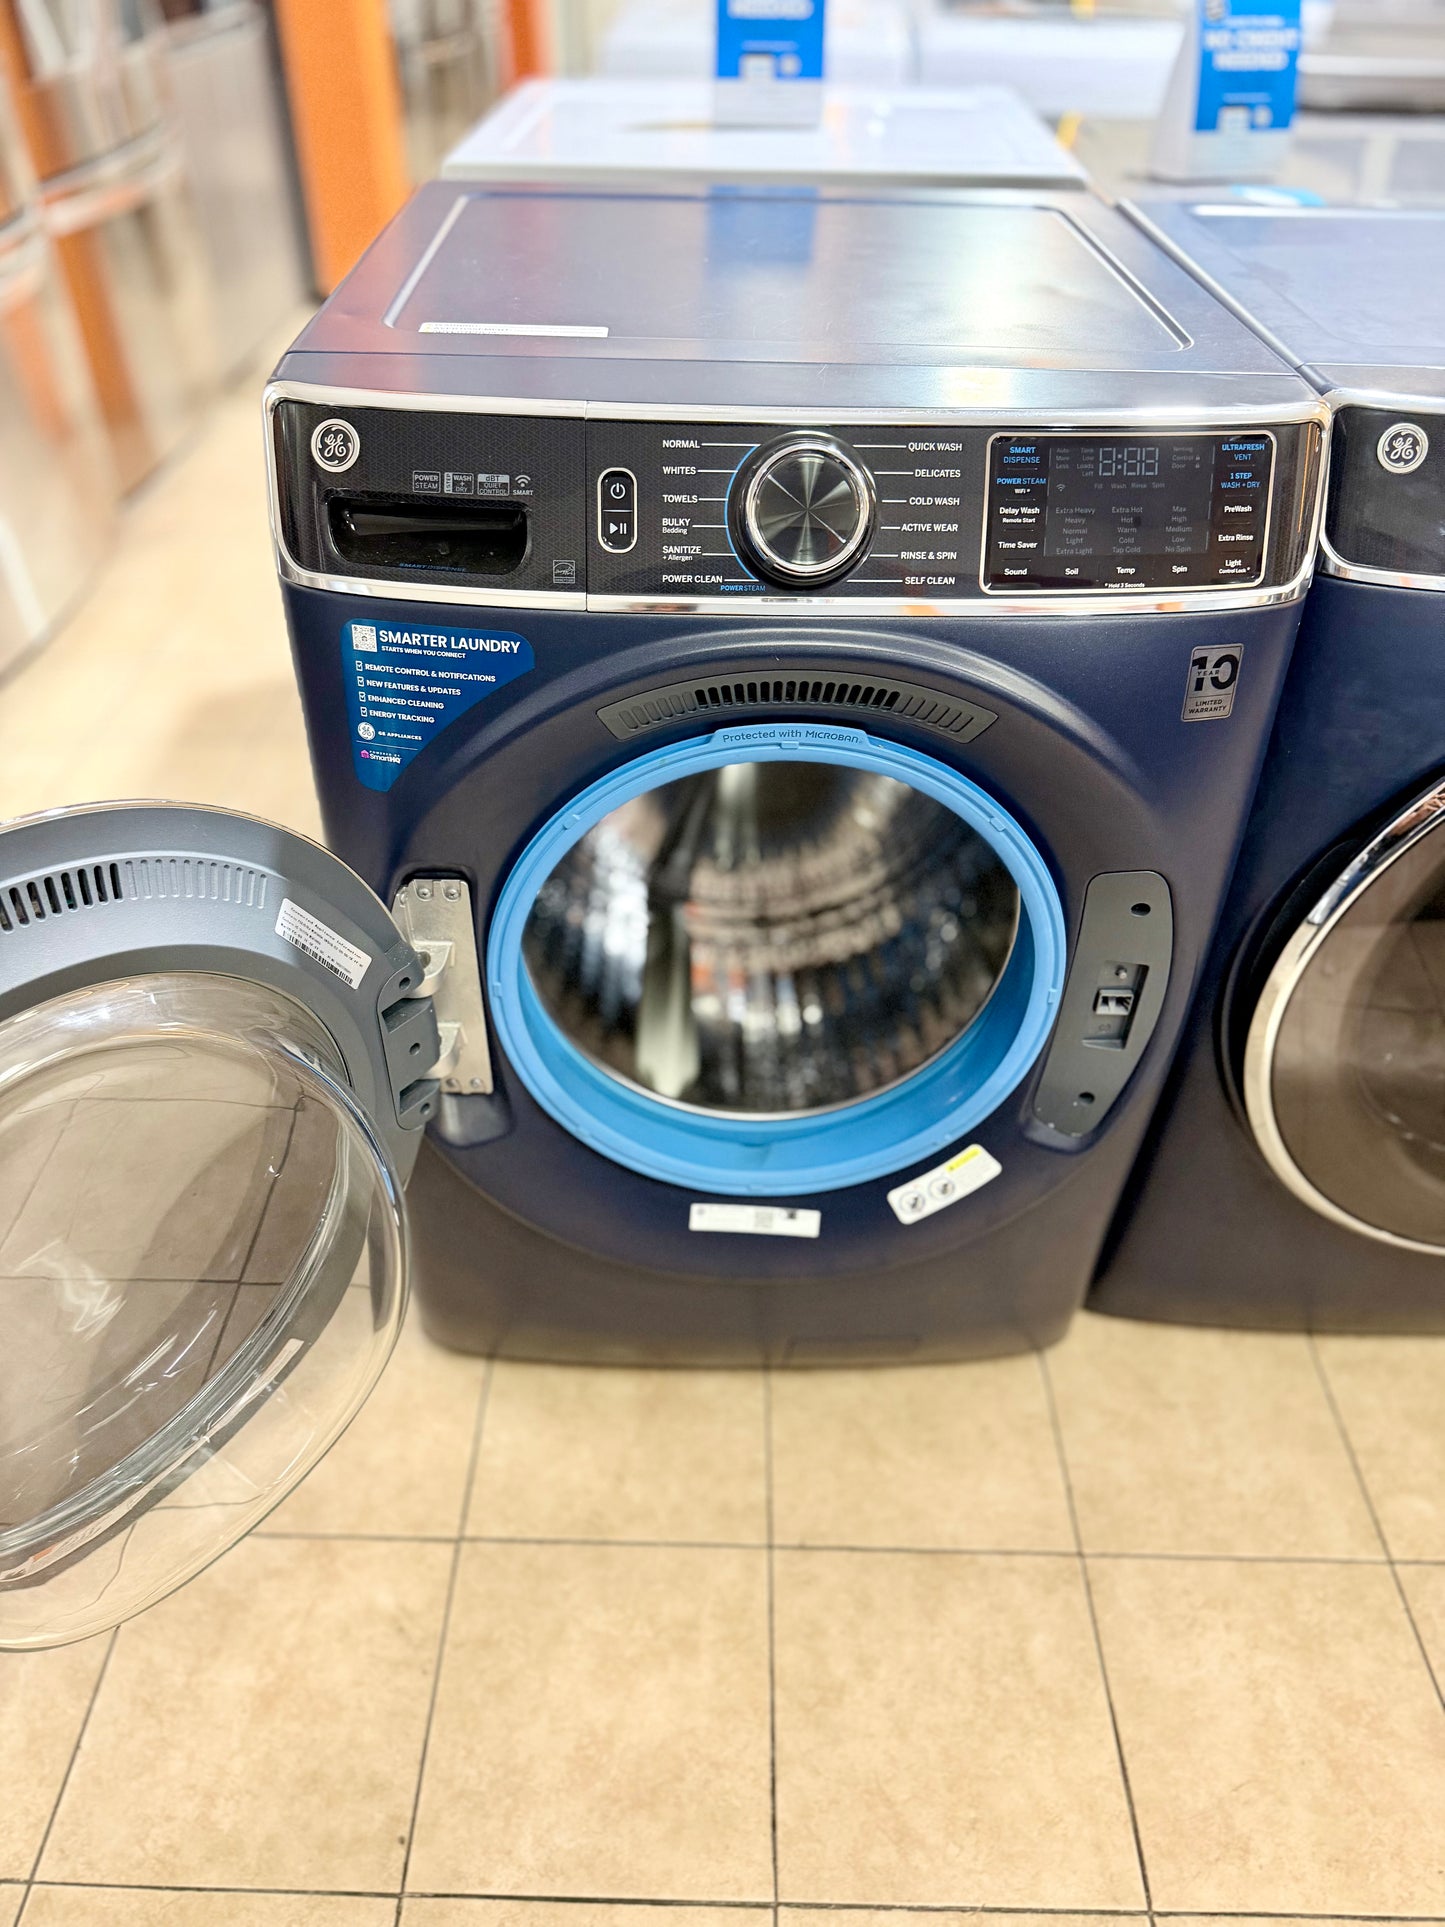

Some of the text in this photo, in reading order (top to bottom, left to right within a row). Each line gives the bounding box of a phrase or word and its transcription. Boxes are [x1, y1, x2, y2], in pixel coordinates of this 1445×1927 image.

[662, 440, 700, 448] NORMAL
[908, 442, 963, 452] QUICK WASH
[1004, 456, 1040, 464] DISPENSE
[662, 466, 697, 475] WHITES
[914, 469, 961, 478] DELICATES
[662, 495, 698, 503] TOWELS
[909, 497, 960, 506] COLD WASH
[999, 507, 1019, 516] Delay
[1075, 507, 1095, 515] Heavy
[1224, 505, 1252, 513] PreWash
[662, 518, 690, 526] BULKY
[662, 527, 688, 535] Bedding
[901, 523, 958, 532] ACTIVE WEAR
[662, 546, 702, 554] SANITIZE
[1075, 547, 1092, 555] Light
[901, 552, 957, 560] RINSE & SPIN
[1225, 560, 1242, 568] Light
[1004, 568, 1028, 576] Sound
[1116, 567, 1136, 575] Temp
[1172, 565, 1188, 574] Spin
[662, 575, 692, 583] POWER
[905, 577, 956, 585] SELF CLEAN
[379, 630, 520, 654] SMARTER LAUNDRY
[365, 664, 394, 673] REMOTE
[394, 667, 430, 677] CONTROL
[438, 672, 496, 682] NOTIFICATIONS
[1192, 654, 1239, 691] 10
[366, 680, 383, 688] NEW
[384, 682, 419, 692] FEATURES
[428, 686, 461, 695] UPDATES
[368, 695, 444, 709] ENHANCED CLEANING
[1196, 699, 1222, 707] LIMITED
[1189, 706, 1226, 714] WARRANTY
[369, 710, 435, 723] ENERGY TRACKING
[387, 732, 422, 740] APPLIANCES
[723, 730, 776, 742] Protected
[778, 729, 801, 738] with
[370, 754, 401, 764] SmartHQ
